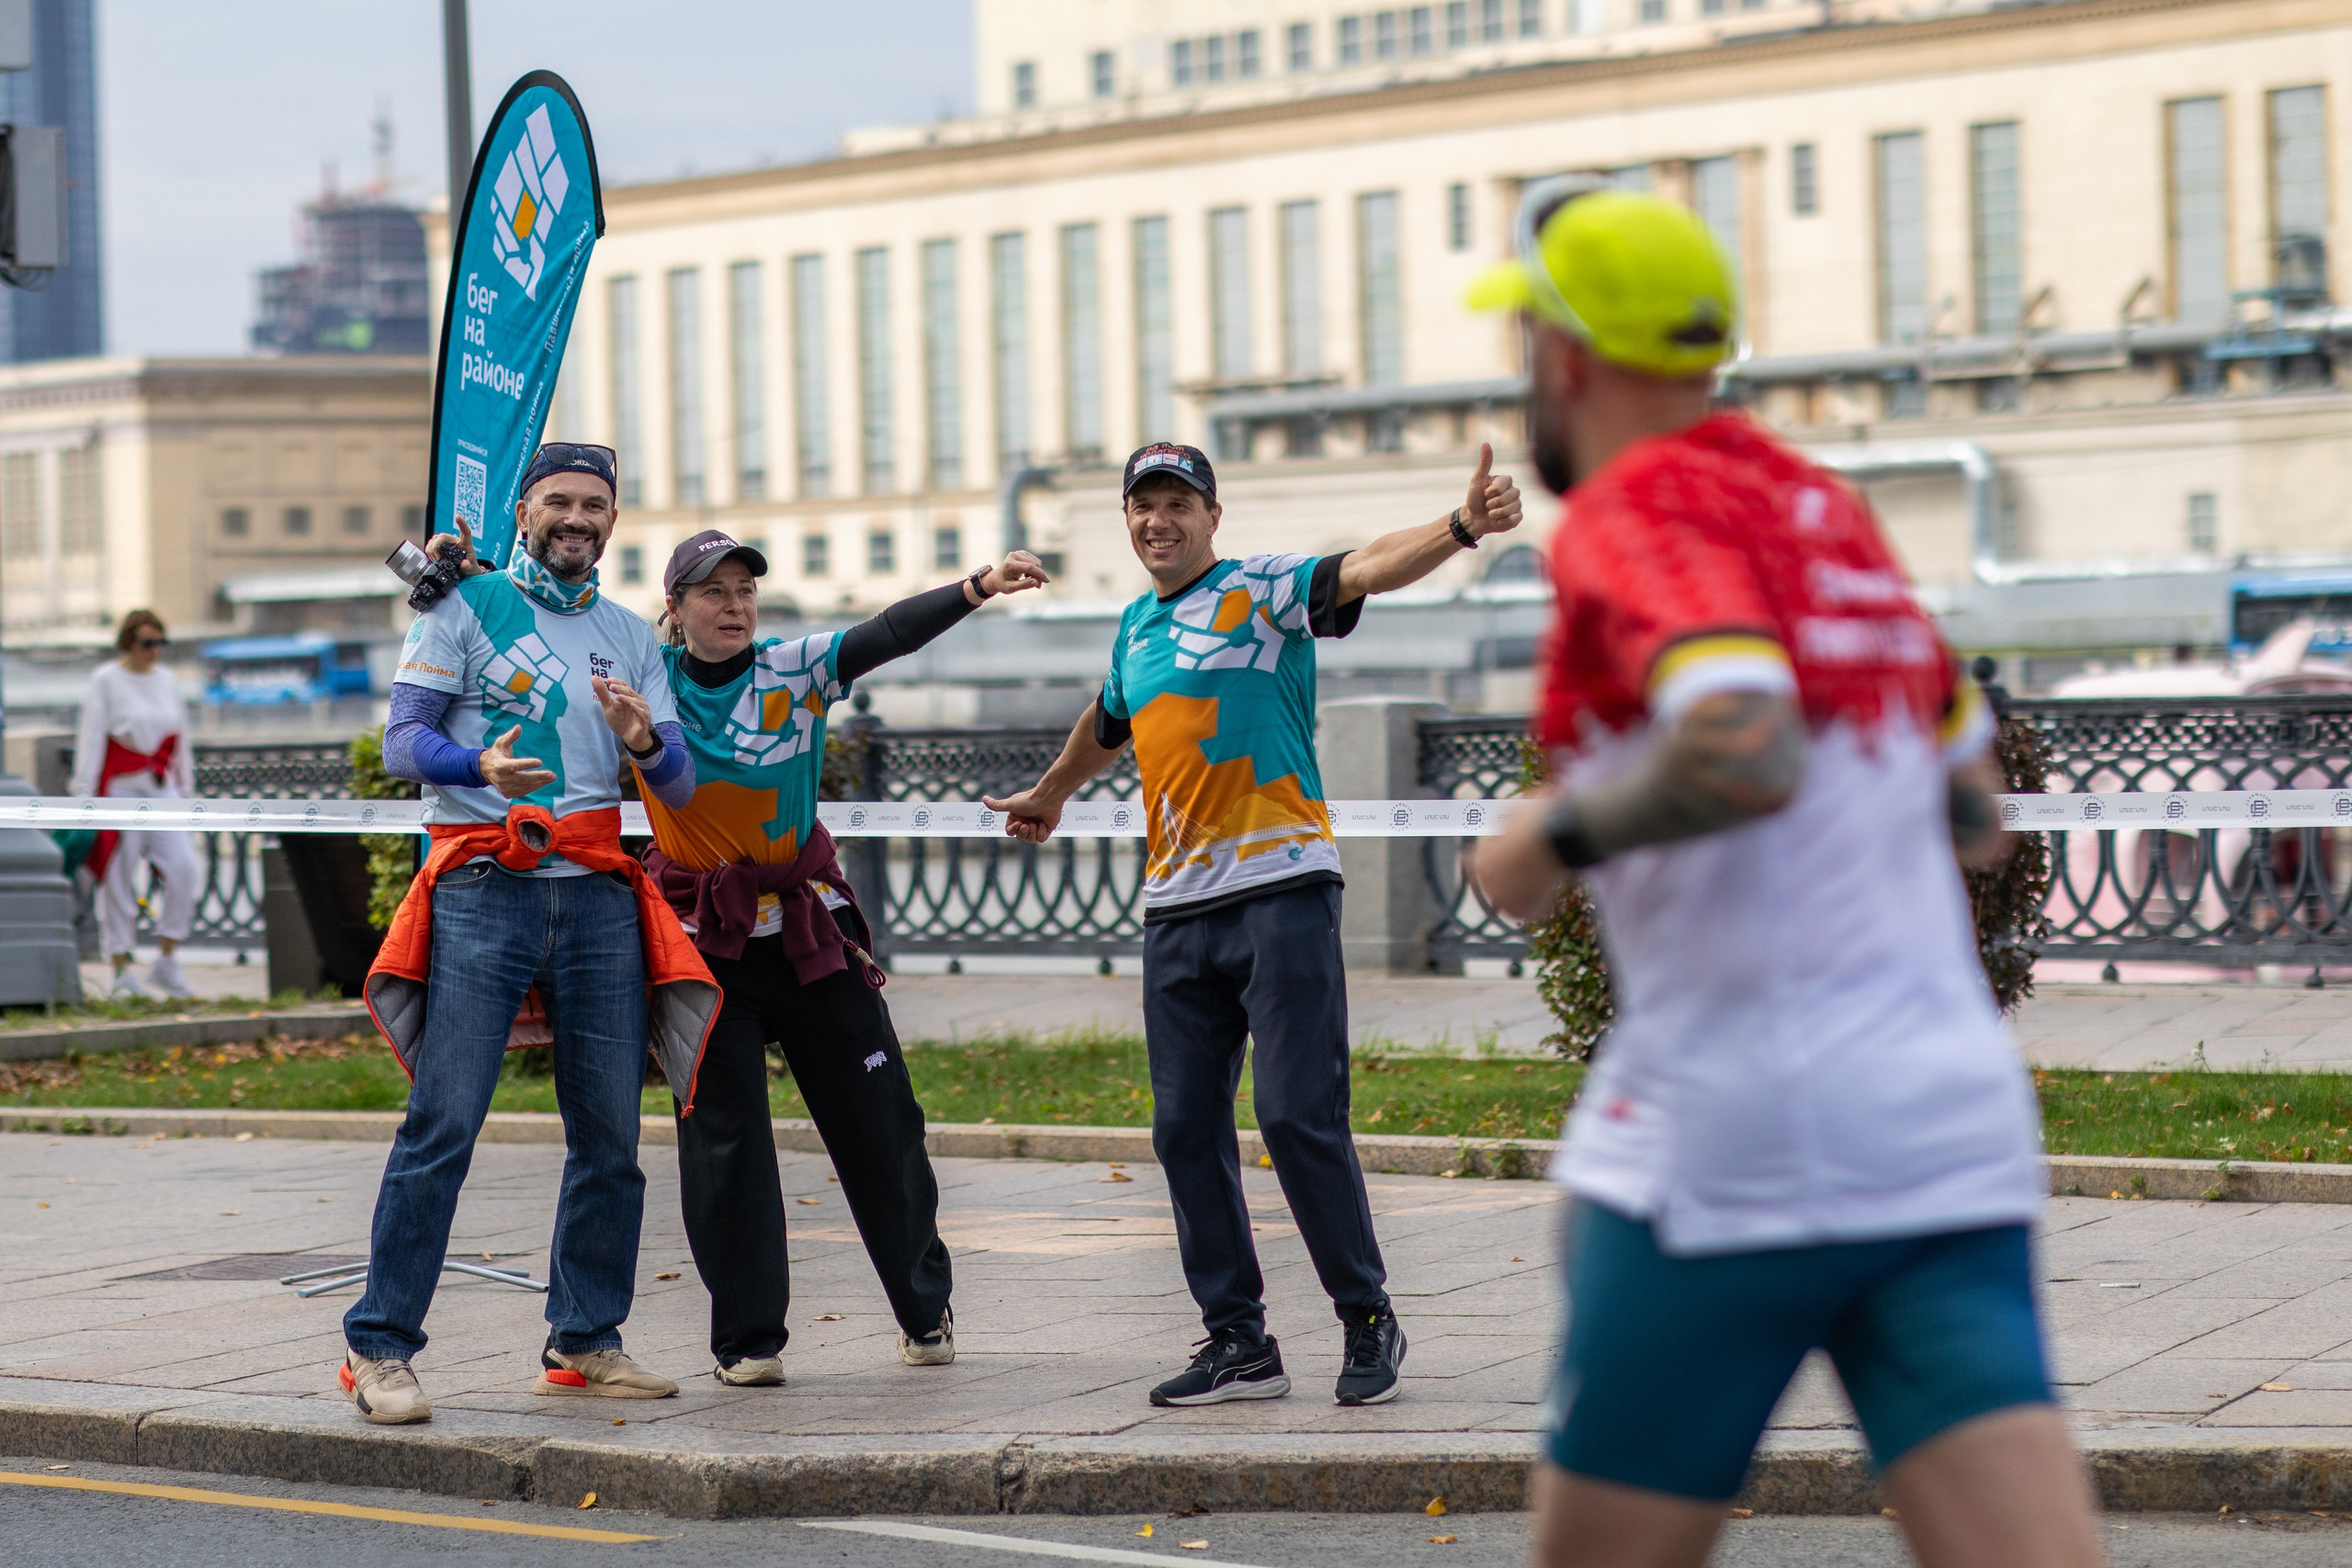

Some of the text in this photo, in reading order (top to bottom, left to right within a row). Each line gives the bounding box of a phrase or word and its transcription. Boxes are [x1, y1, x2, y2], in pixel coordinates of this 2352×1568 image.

[467, 272, 499, 315] бег
[464, 314, 485, 346] на
[460, 350, 525, 400] районе
[419, 661, 456, 678] Пойма
[589, 652, 615, 670] бег
[591, 667, 609, 679] на
